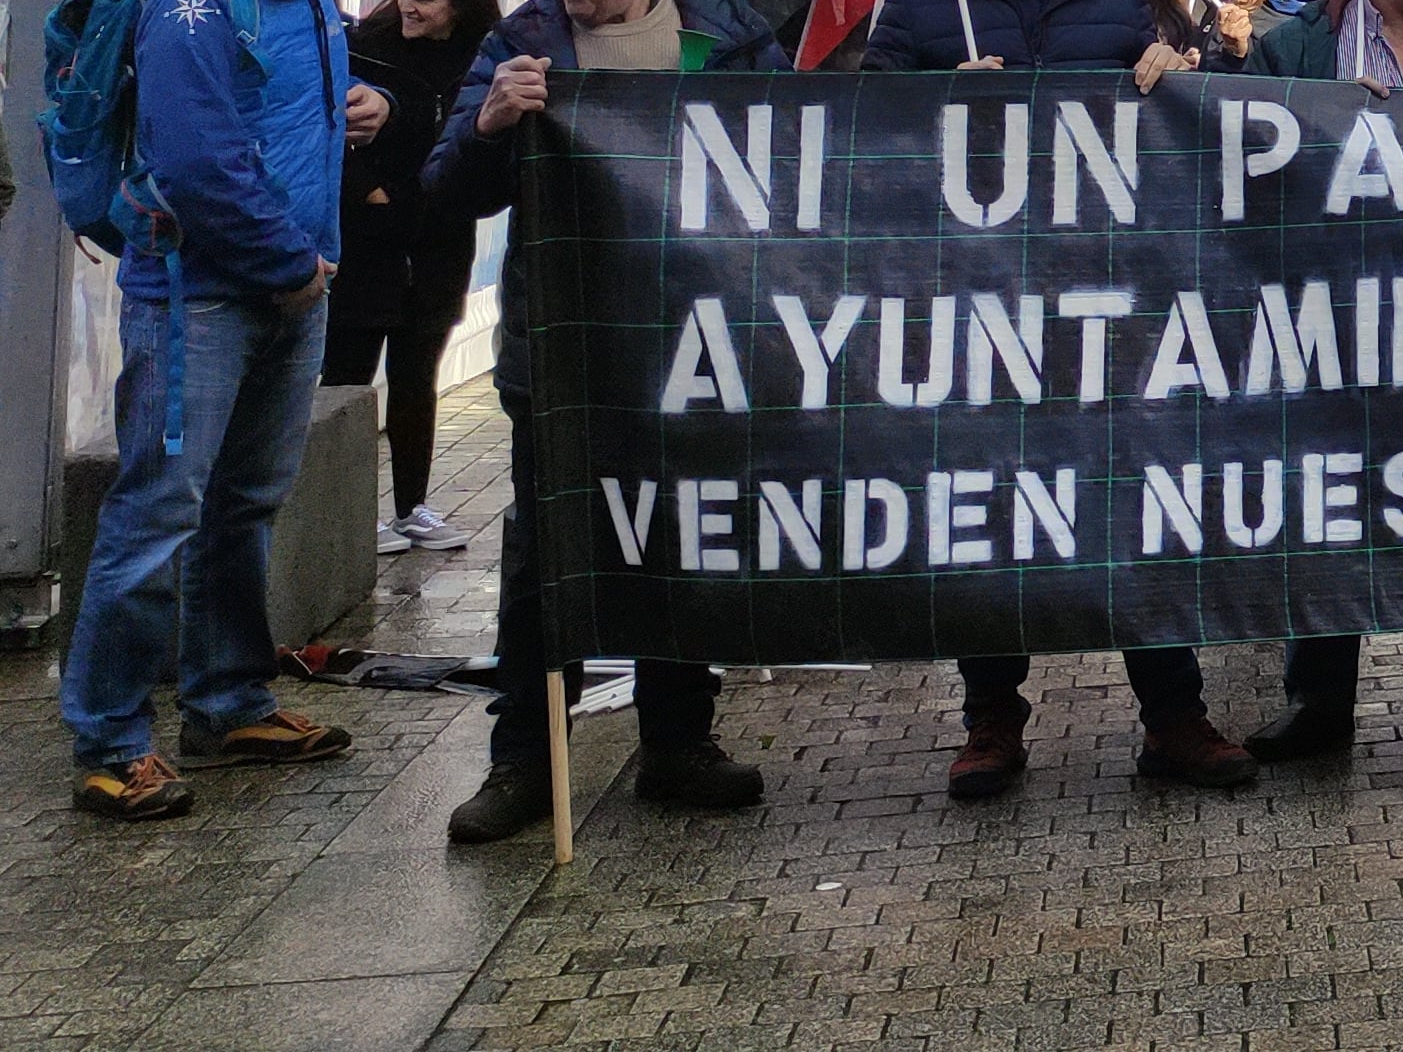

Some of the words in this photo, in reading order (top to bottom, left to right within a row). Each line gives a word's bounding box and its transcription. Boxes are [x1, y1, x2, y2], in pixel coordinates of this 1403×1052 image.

[679, 103, 826, 231] NI
[941, 101, 1139, 228] UN
[601, 467, 1078, 572] VENDEN
